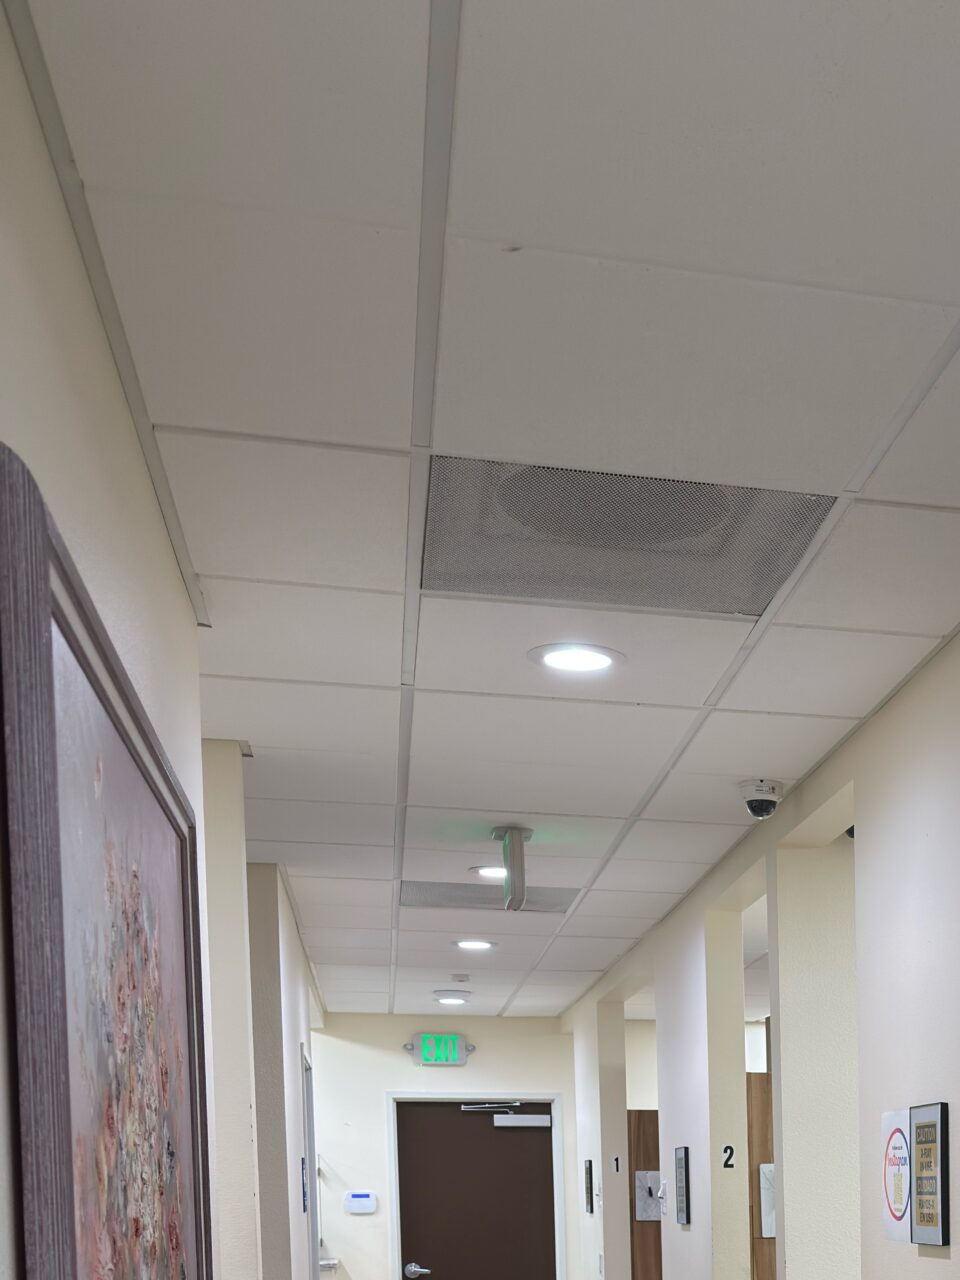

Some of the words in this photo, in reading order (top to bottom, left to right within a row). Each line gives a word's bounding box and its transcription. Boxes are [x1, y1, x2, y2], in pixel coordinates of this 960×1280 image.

[421, 1034, 459, 1062] EXIT
[614, 1157, 619, 1172] 1
[723, 1145, 734, 1168] 2
